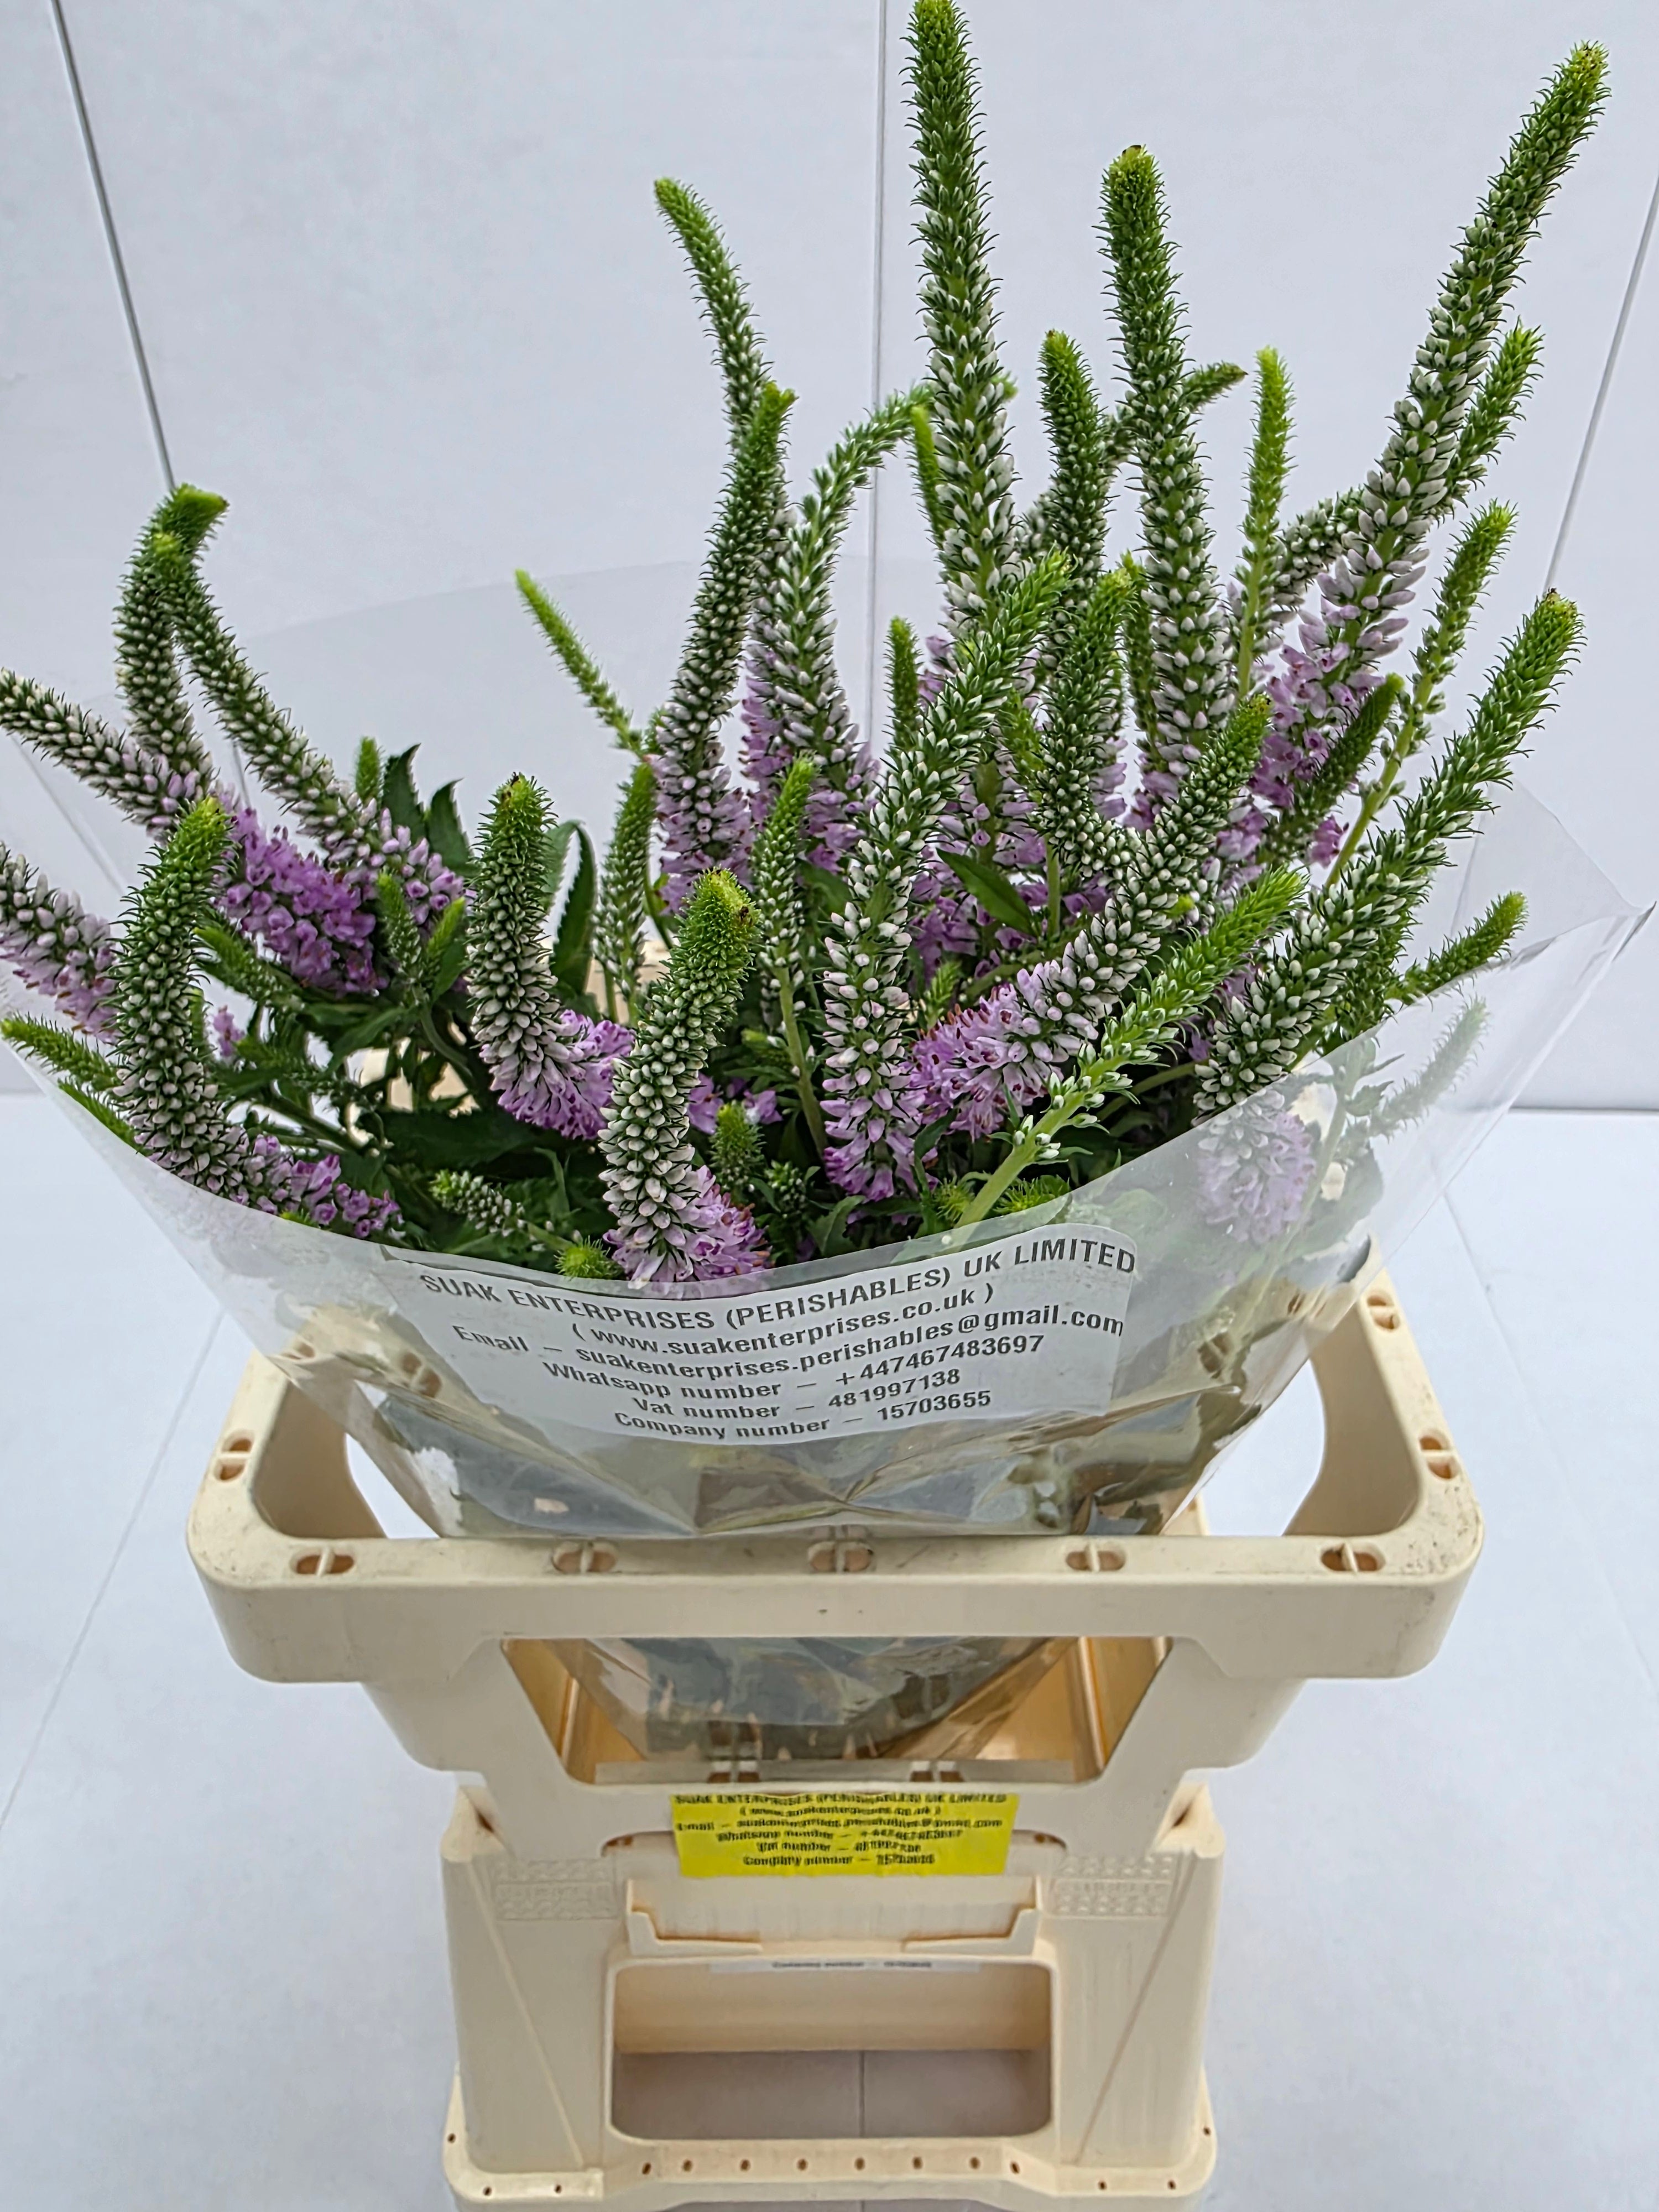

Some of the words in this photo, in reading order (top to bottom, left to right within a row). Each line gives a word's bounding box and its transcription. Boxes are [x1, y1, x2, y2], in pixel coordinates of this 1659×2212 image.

[419, 1275, 502, 1303] SUAK
[507, 1289, 715, 1329] ENTERPRISES
[726, 1267, 951, 1330] (PERISHABLES)
[964, 1251, 1002, 1278] UK
[1014, 1238, 1135, 1274] LIMITED
[452, 1325, 529, 1352] Email
[576, 1305, 1124, 1381] suakenterprises.perishables@gmail.com
[590, 1288, 975, 1355] www.suakenterprises.co.uk
[542, 1361, 671, 1399] Whatsapp
[680, 1383, 781, 1399] number
[836, 1335, 1045, 1385] +447467483697
[632, 1397, 674, 1416] Vat
[682, 1405, 780, 1419] number
[828, 1368, 961, 1407] 481997138
[614, 1412, 726, 1439] Company
[735, 1419, 830, 1437] number
[877, 1390, 991, 1421] 15703655
